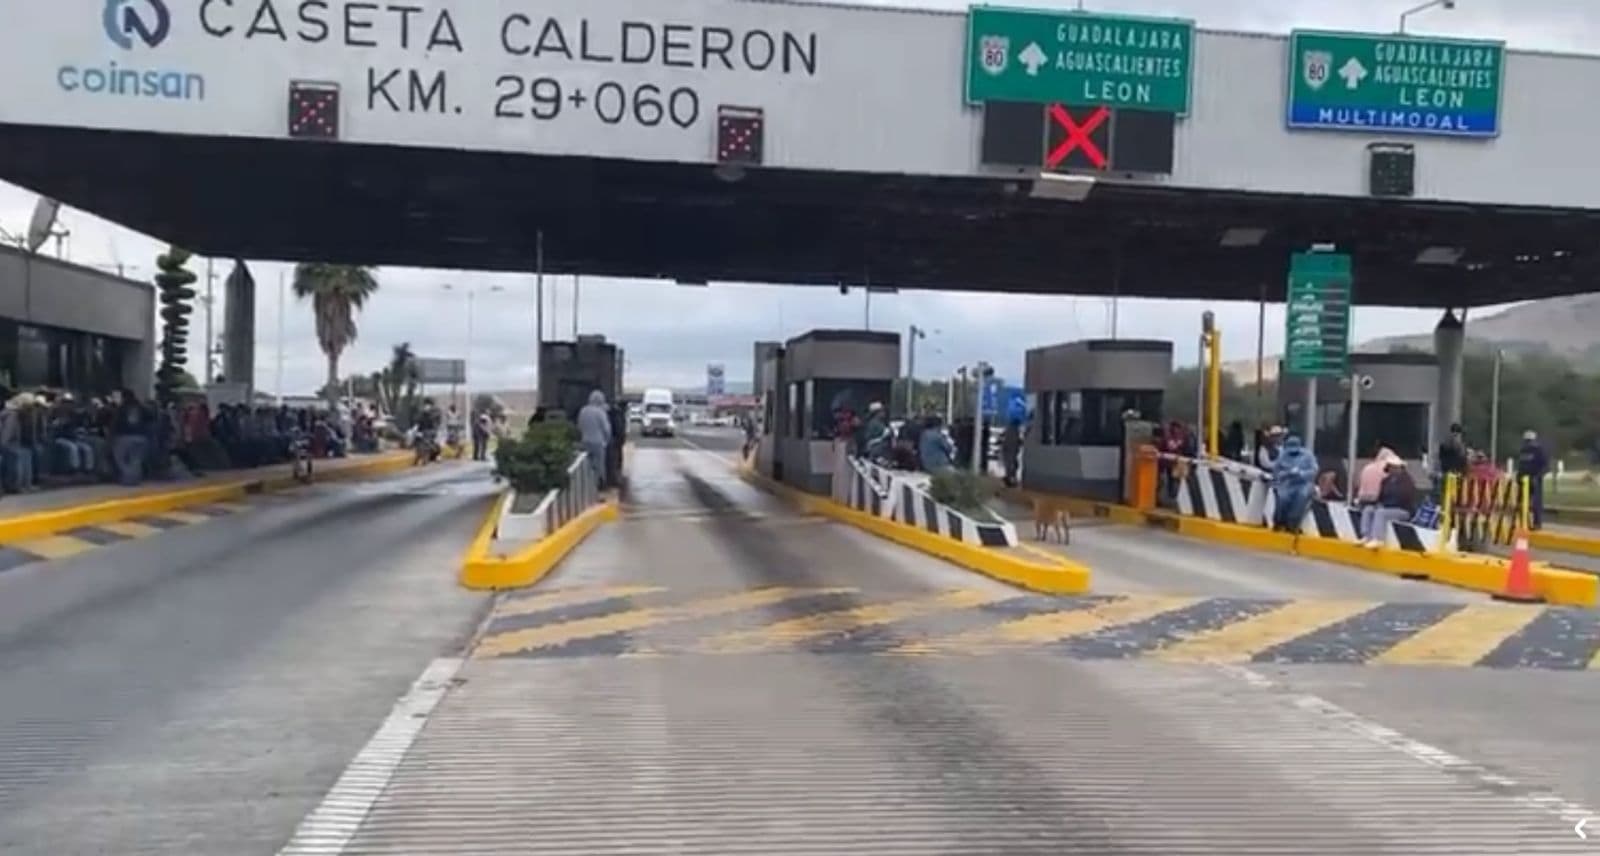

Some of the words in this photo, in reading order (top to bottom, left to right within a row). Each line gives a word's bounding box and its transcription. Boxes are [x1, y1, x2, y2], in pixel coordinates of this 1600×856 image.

[198, 0, 463, 53] CASETA
[500, 13, 818, 76] CALDERON
[1057, 23, 1183, 50] GUADALAJARA
[1056, 51, 1182, 78] AGUASCALIENTES
[1375, 43, 1493, 67] GUADALAJARA
[57, 61, 205, 101] coinsan
[1373, 66, 1492, 89] AGUASCALIENTES
[366, 67, 463, 115] KM.
[494, 74, 699, 129] 29+060
[1084, 81, 1150, 103] LEON
[1399, 87, 1463, 108] LEON
[1318, 107, 1470, 131] MULTIMODAL
